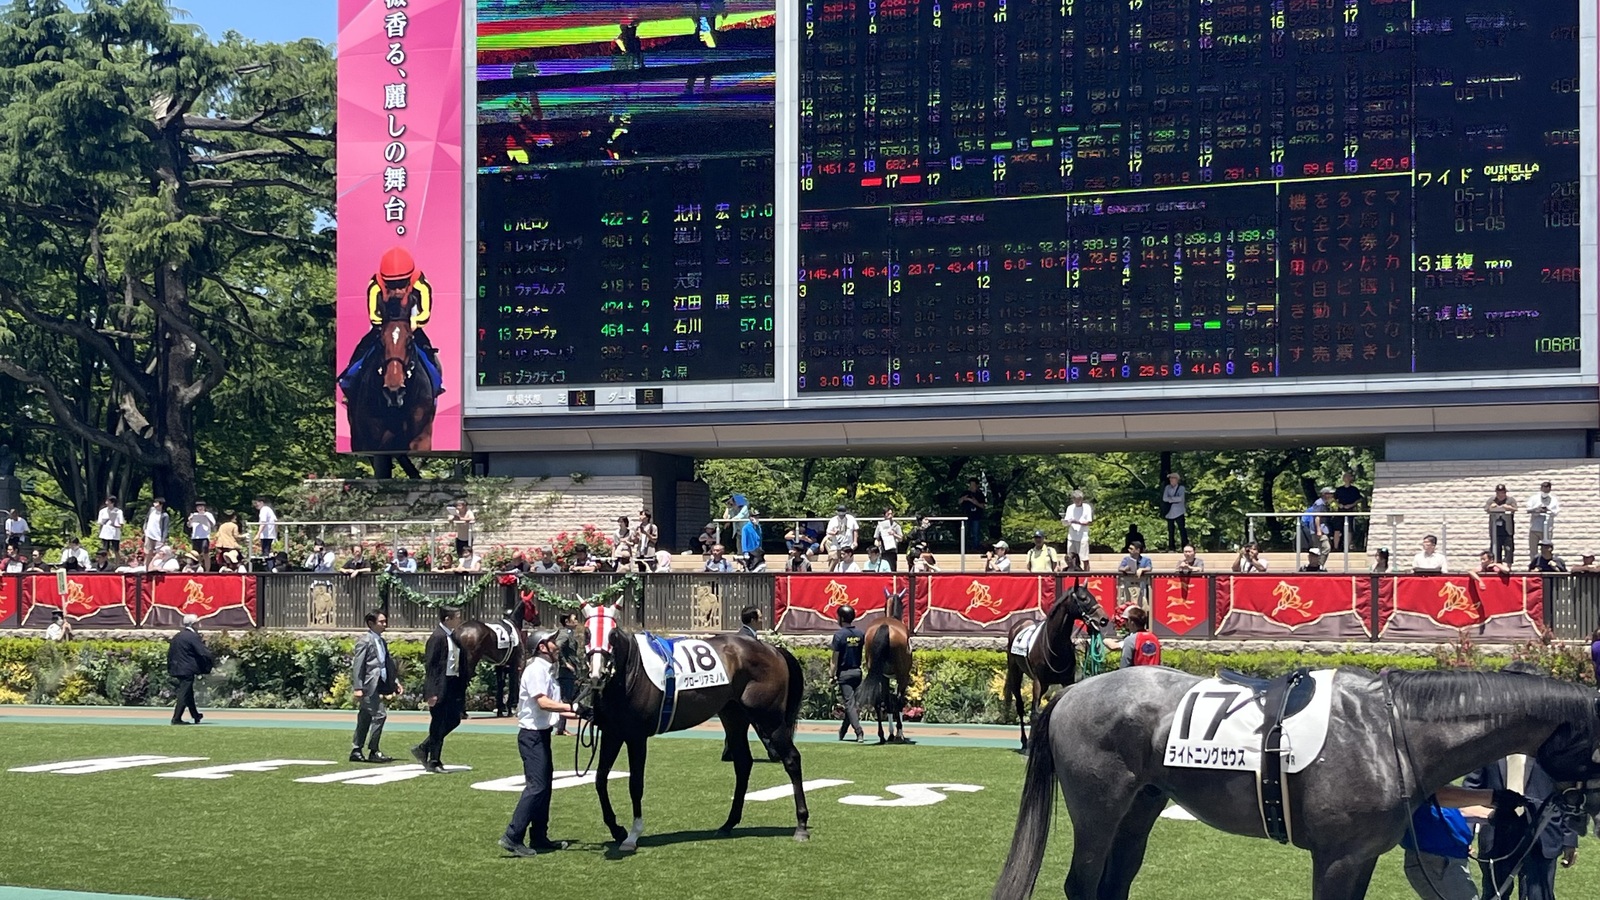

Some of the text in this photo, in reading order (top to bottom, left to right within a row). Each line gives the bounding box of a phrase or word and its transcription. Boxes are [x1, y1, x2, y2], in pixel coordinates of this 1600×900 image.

[1343, 8, 1358, 23] 17
[1270, 149, 1285, 163] 17
[1343, 145, 1359, 159] 17
[817, 161, 856, 175] 1451.2
[1127, 159, 1143, 172] 17
[1197, 154, 1213, 168] 17
[801, 163, 814, 177] 17
[993, 168, 1006, 181] 17
[1059, 164, 1074, 177] 17
[1270, 163, 1284, 178] 18
[1417, 163, 1540, 187] ワイド QUINELLA
[885, 173, 899, 188] 17
[927, 172, 940, 185] 17
[674, 203, 702, 222] 北村
[1454, 215, 1505, 232] 01-05
[1122, 229, 1235, 248] 2 10.4 4
[1140, 248, 1169, 260] 14.1
[1417, 252, 1513, 272] 3連複 TRIO
[798, 265, 889, 282] 2 145.4 11 46.4
[893, 264, 902, 277] 2
[946, 261, 975, 274] 43.4
[977, 258, 990, 272] 11
[1071, 269, 1080, 281] 3
[1173, 264, 1182, 276] 5
[892, 274, 990, 293] 3 12
[1288, 193, 1307, 363] 機で利用できます
[798, 282, 856, 297] 3 12
[674, 295, 702, 311] 江田
[715, 293, 731, 310] 照
[498, 327, 512, 341] 13
[515, 325, 557, 341] スラーヴァ
[641, 322, 650, 336] 4
[673, 317, 702, 335] 石川
[740, 316, 773, 333] 57.0
[842, 358, 855, 372] 17
[893, 354, 990, 371] 8 17
[1089, 351, 1099, 365] 8
[892, 374, 902, 387] 9
[955, 370, 975, 383] 1.5
[1043, 367, 1067, 380] 2.0
[1070, 366, 1080, 379] 8
[1088, 365, 1116, 378] 42.1
[1121, 364, 1131, 378] 8
[1191, 362, 1221, 375] 41.6
[1250, 360, 1274, 373] 6.1
[819, 373, 841, 387] 3.0
[868, 371, 889, 386] 3.6
[608, 391, 635, 402] ダート
[680, 643, 717, 674] 18
[682, 672, 726, 688] グローリアミノル
[1178, 690, 1242, 742] 17
[1167, 744, 1247, 768] ライトニングゼウス
